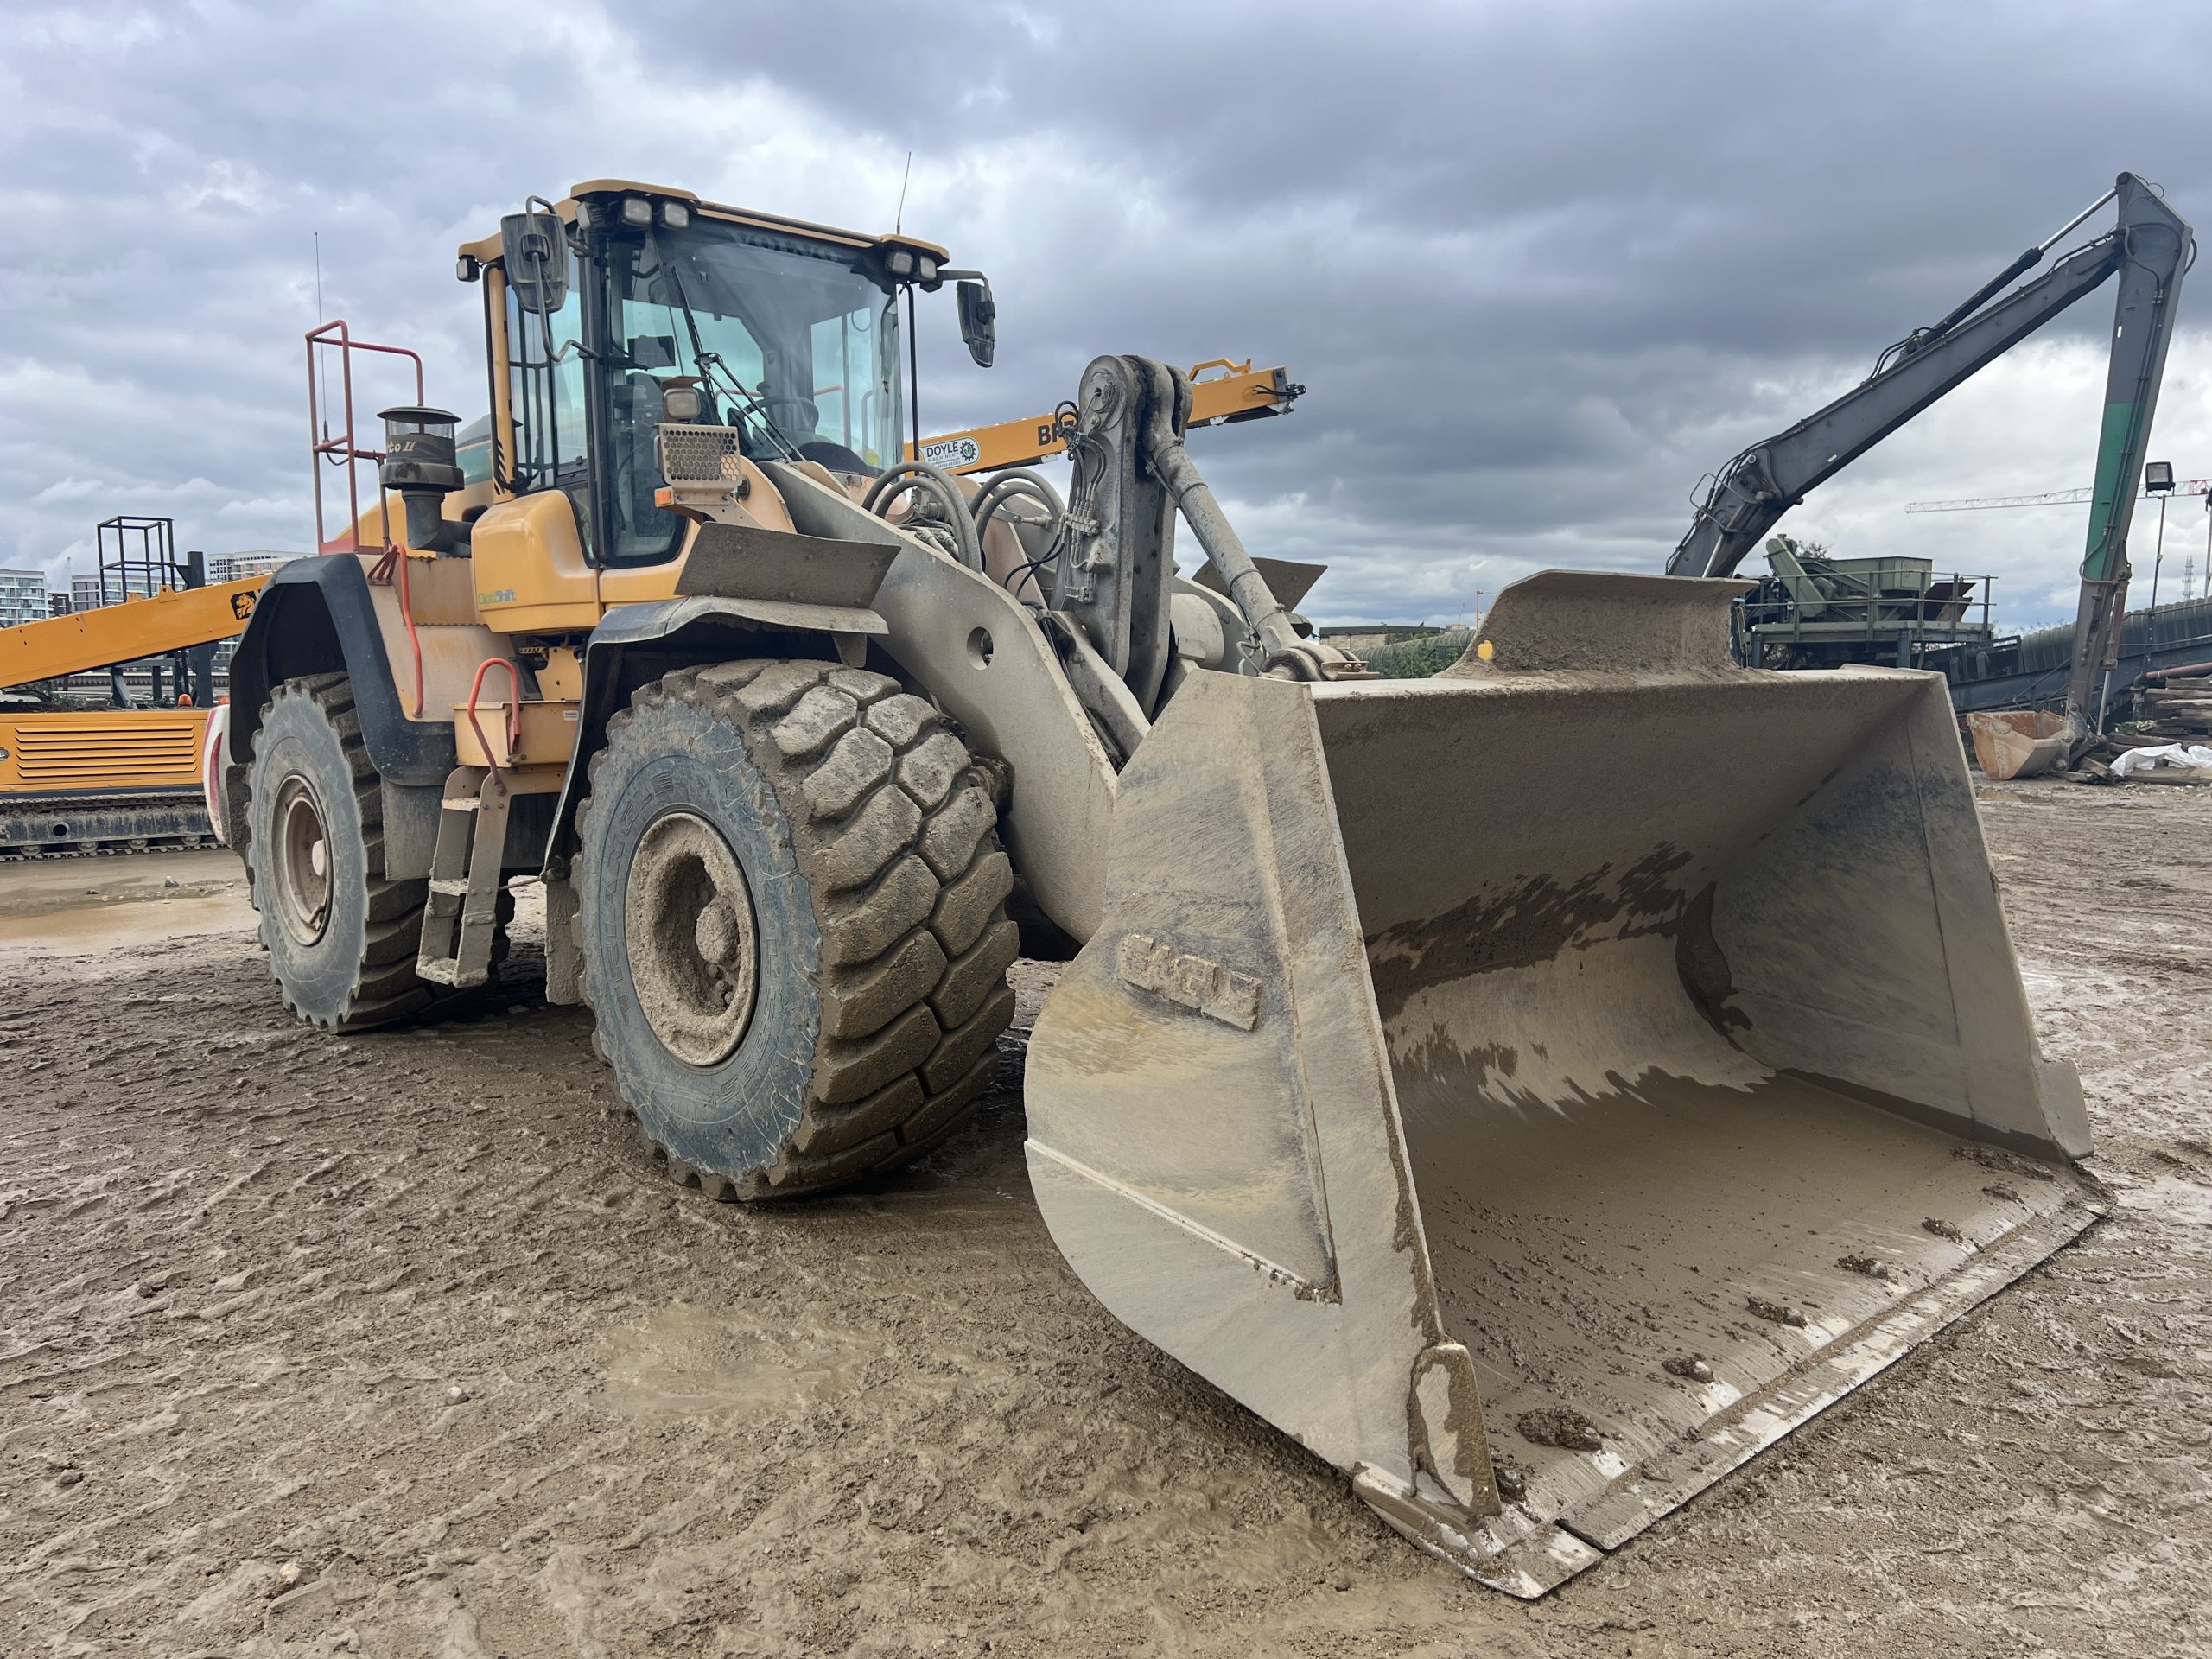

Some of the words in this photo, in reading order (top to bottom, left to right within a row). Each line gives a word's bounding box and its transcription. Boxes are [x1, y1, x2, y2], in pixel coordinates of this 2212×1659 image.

[926, 442, 958, 457] DOYLE
[927, 452, 959, 462] MACHINERY
[603, 770, 674, 1025] TRIANGLE
[1121, 934, 1263, 1032] EAGLE
